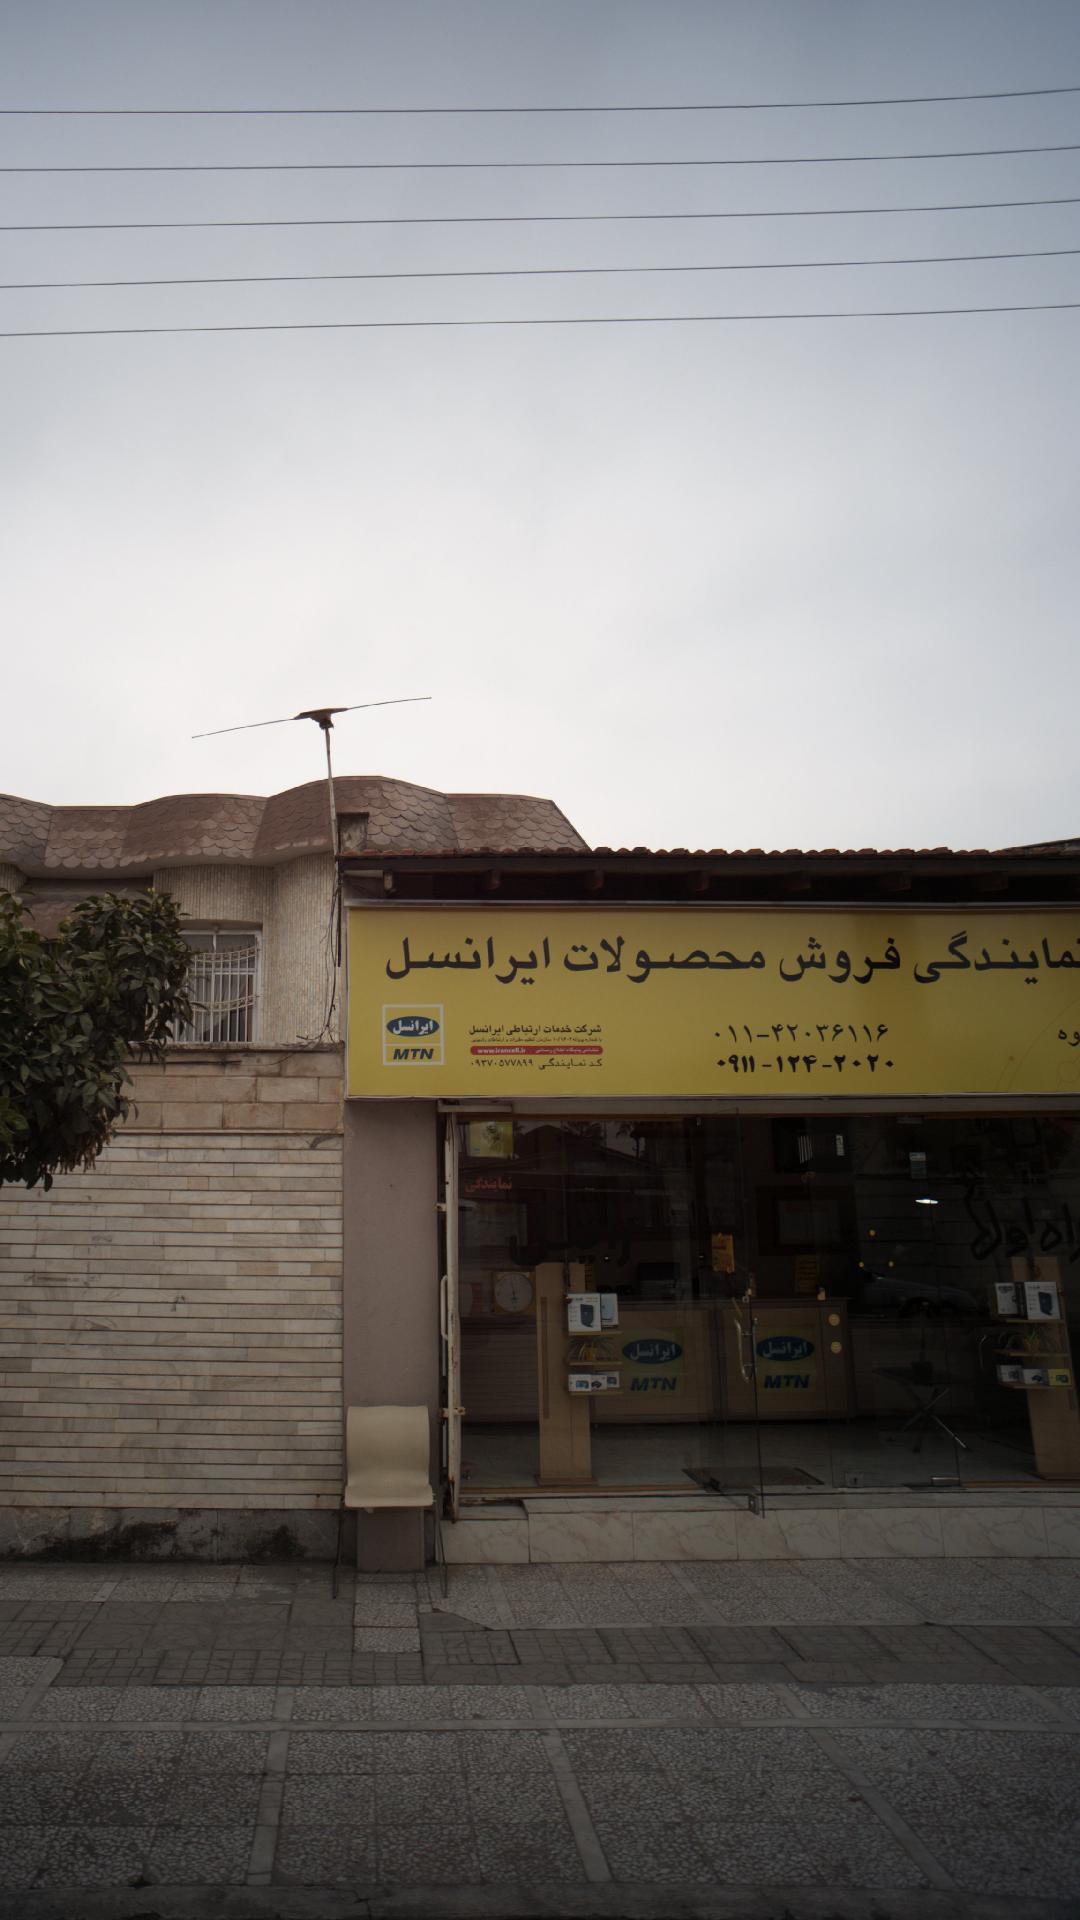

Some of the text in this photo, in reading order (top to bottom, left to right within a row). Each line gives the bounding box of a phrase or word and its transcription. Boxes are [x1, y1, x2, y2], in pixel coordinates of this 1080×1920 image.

[385, 936, 551, 985] ایرانسل
[563, 936, 766, 984] محصولات
[779, 936, 901, 985] فروش
[392, 1019, 434, 1035] ایرانسل
[469, 1024, 602, 1036] شرکت خدمات ارتباطی ایرانسل
[393, 1048, 434, 1060] MTN
[538, 1058, 586, 1070] نمایندگی
[589, 1058, 603, 1067] کد
[629, 1343, 677, 1360] ایرانسل
[762, 1341, 808, 1358] ایرانسل
[630, 1376, 677, 1391] MTN
[763, 1374, 810, 1389] MTN
